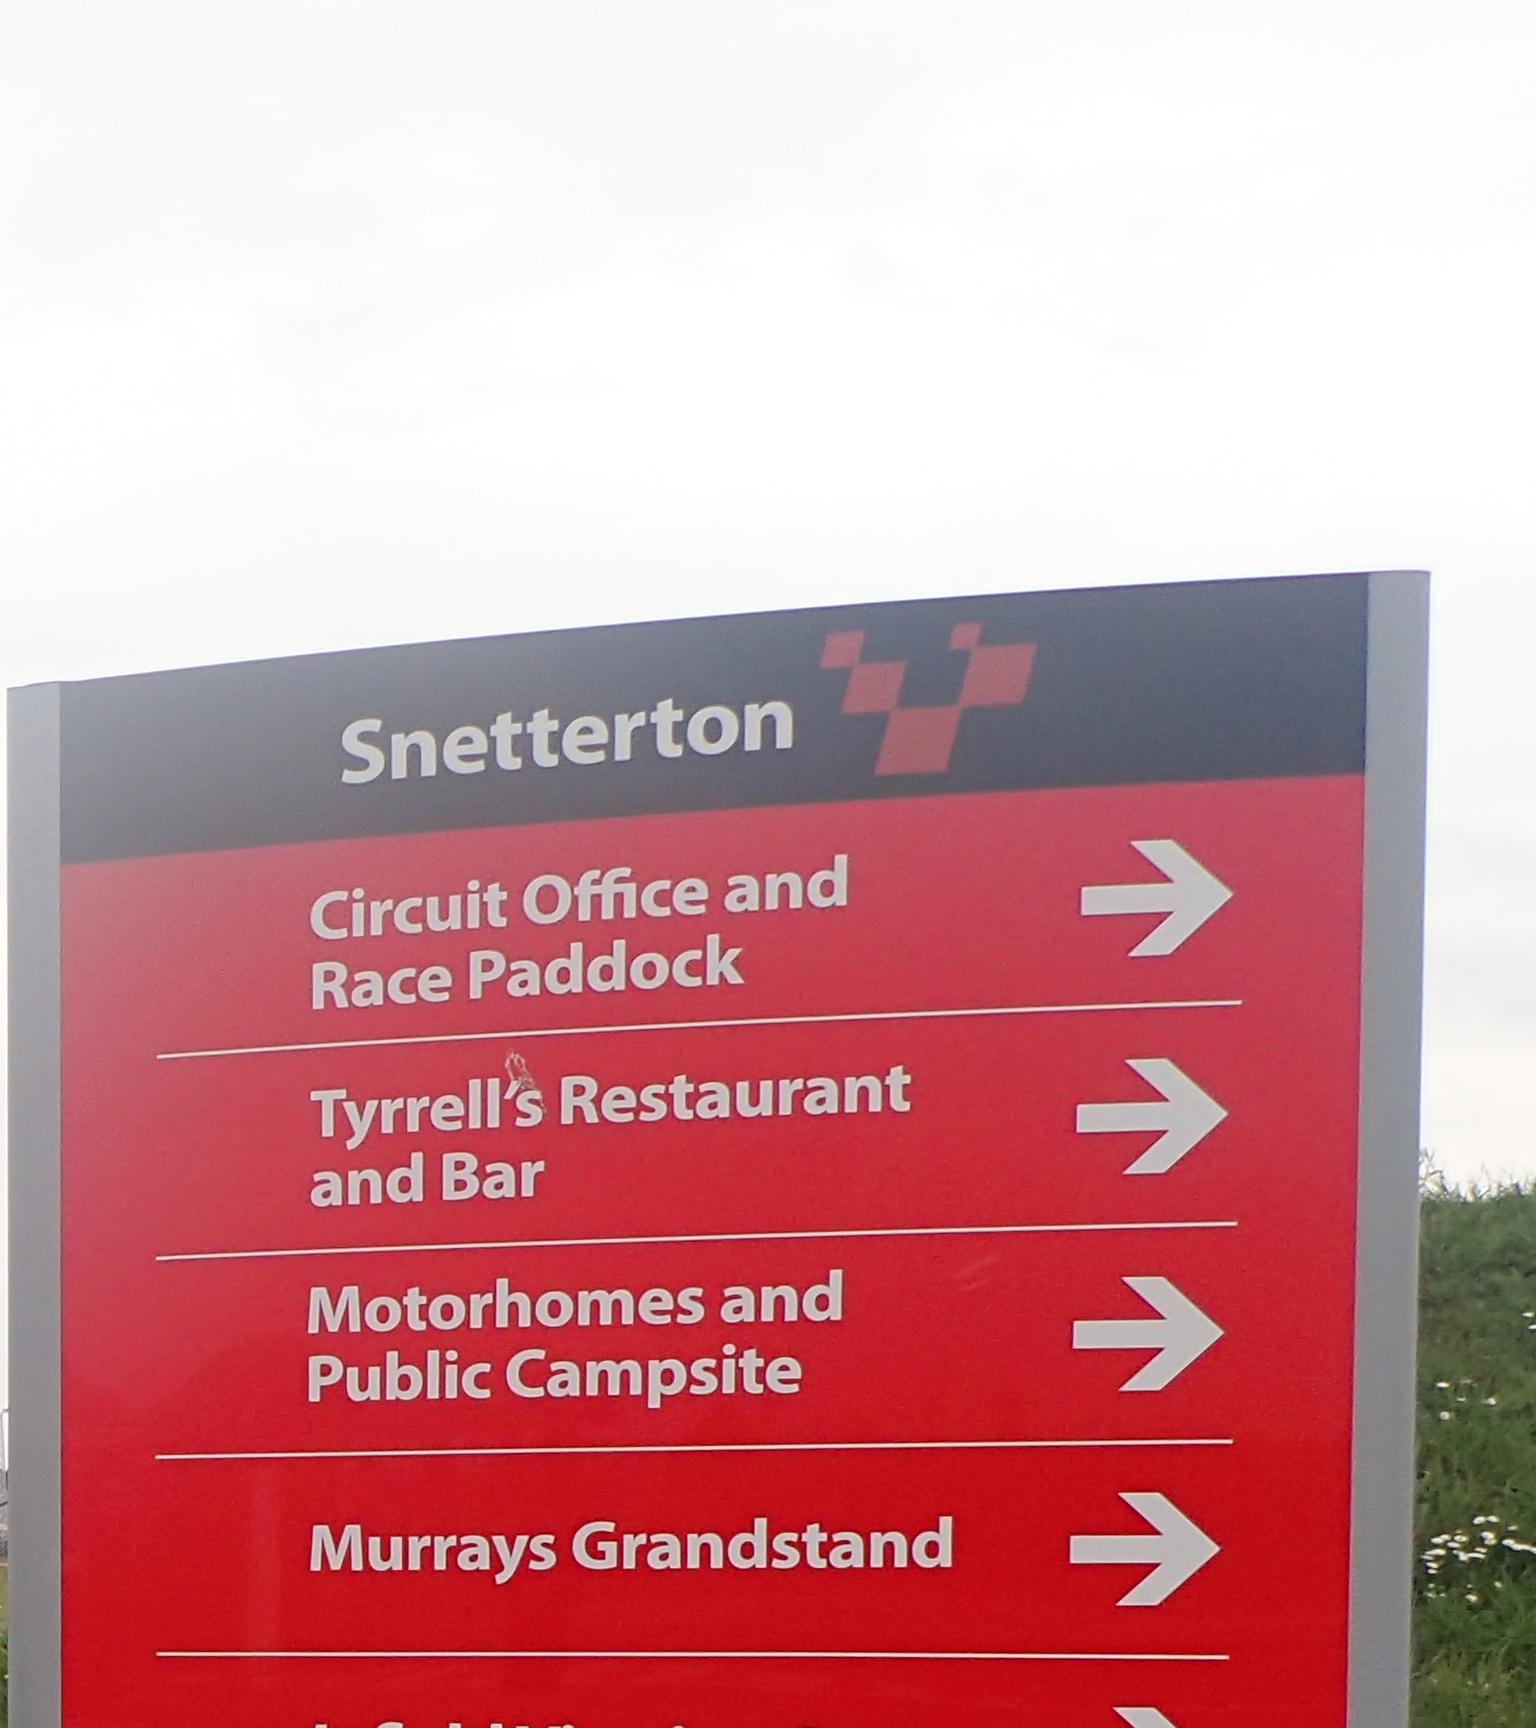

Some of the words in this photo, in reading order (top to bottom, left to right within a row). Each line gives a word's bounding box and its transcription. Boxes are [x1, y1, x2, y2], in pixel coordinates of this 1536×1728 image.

[342, 698, 792, 783] Snetterton
[311, 880, 507, 939] Circuit
[523, 867, 708, 924] Office
[725, 854, 847, 912] and
[313, 962, 452, 1009] Race
[470, 934, 744, 999] Paddock
[561, 1065, 911, 1124] Restaurant
[311, 1152, 423, 1207] and
[443, 1152, 544, 1200] Bar
[308, 1278, 704, 1333] Motorhomes
[721, 1269, 842, 1323] and
[309, 1350, 491, 1402] Public
[507, 1344, 801, 1408] Campsite
[310, 1525, 556, 1584] Murrays
[573, 1516, 952, 1569] Grandstand
